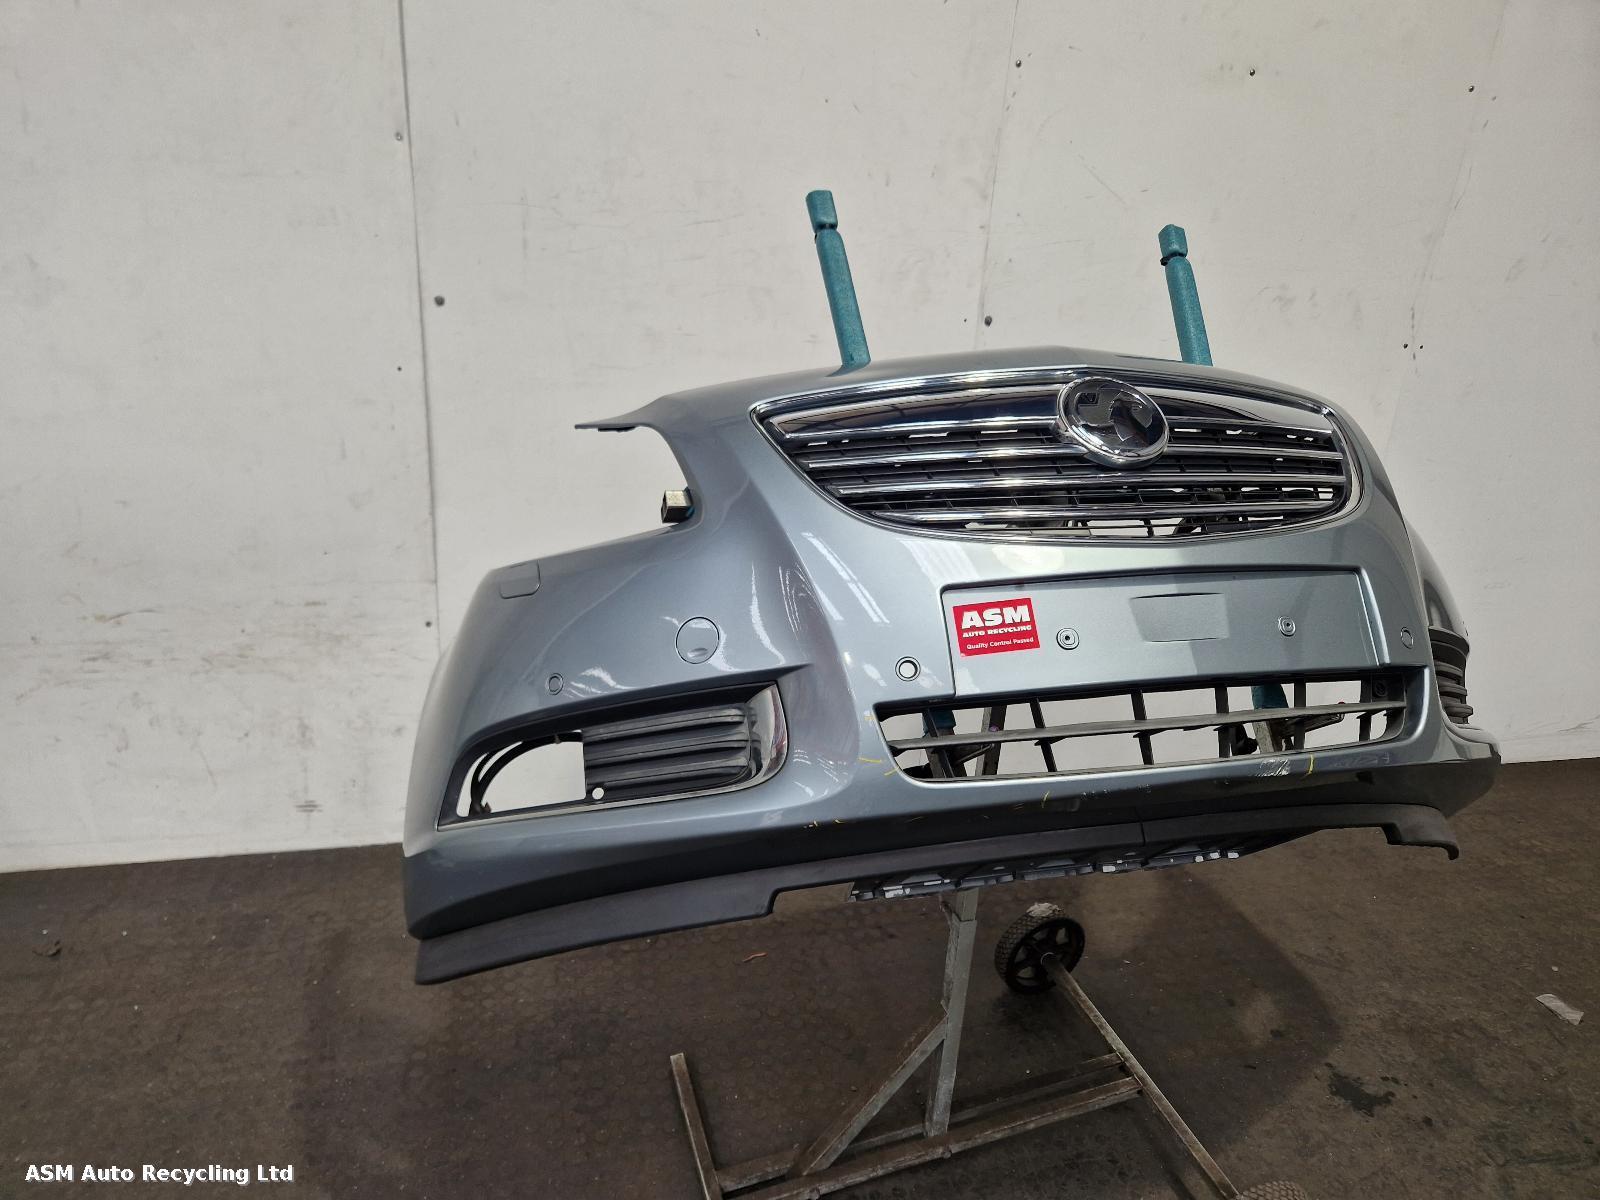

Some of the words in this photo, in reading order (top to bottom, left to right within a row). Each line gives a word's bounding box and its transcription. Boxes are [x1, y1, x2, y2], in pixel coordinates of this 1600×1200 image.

[961, 604, 1031, 629] ASM
[962, 630, 985, 638] AUTO
[987, 625, 1032, 635] RECYCLING
[966, 641, 988, 650] Quality
[989, 639, 1012, 647] Control
[1013, 637, 1034, 645] Passed
